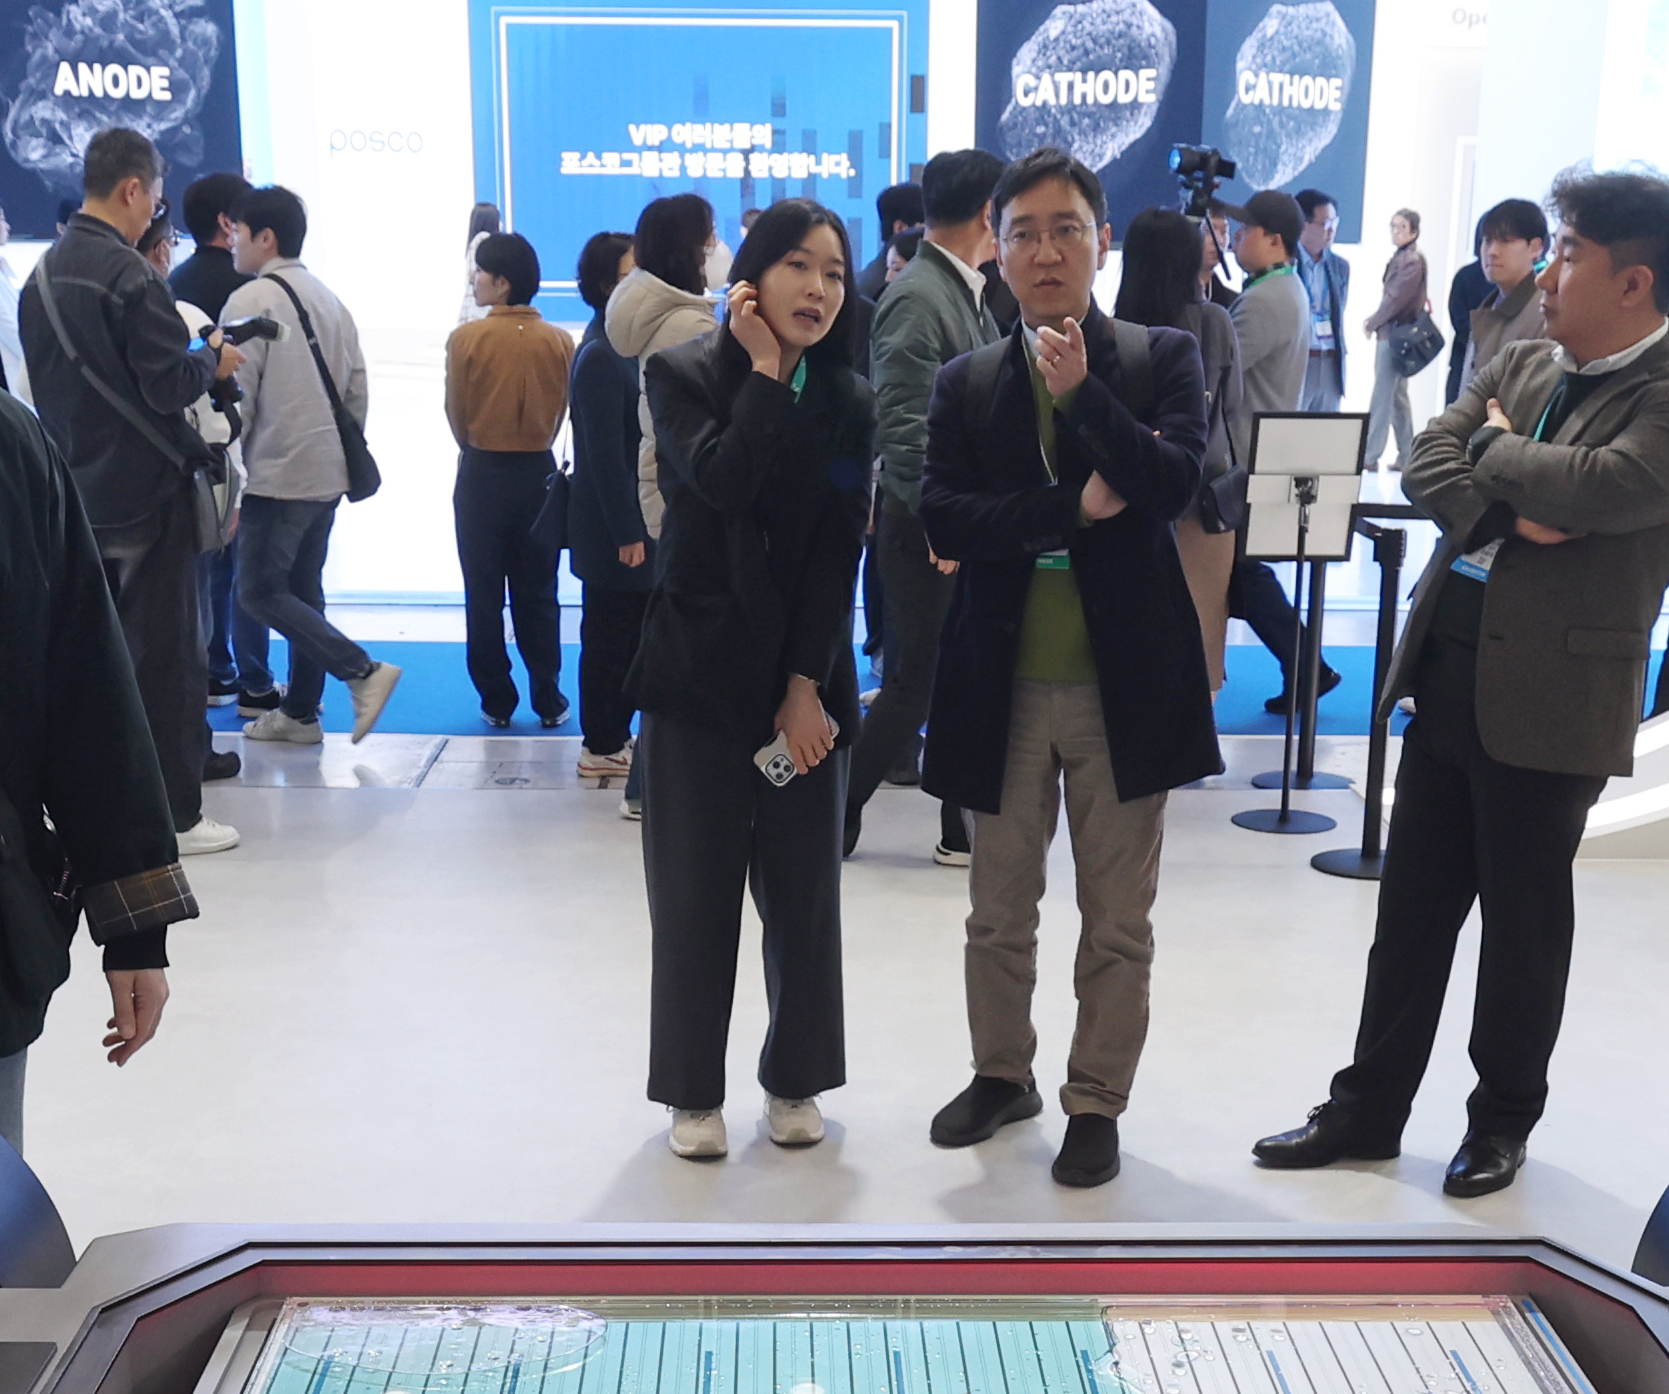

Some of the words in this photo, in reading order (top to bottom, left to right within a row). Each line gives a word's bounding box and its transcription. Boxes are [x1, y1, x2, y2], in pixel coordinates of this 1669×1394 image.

[53, 61, 172, 101] ANODE
[1015, 68, 1158, 107] CATHODE
[1238, 70, 1342, 111] CATHODE
[329, 129, 424, 159] posco
[628, 123, 669, 146] VIP
[671, 121, 773, 149] 여러분들의
[560, 151, 682, 178] 포스코그룹관
[684, 151, 746, 178] 방문을
[748, 152, 857, 179] 환영합니다.
